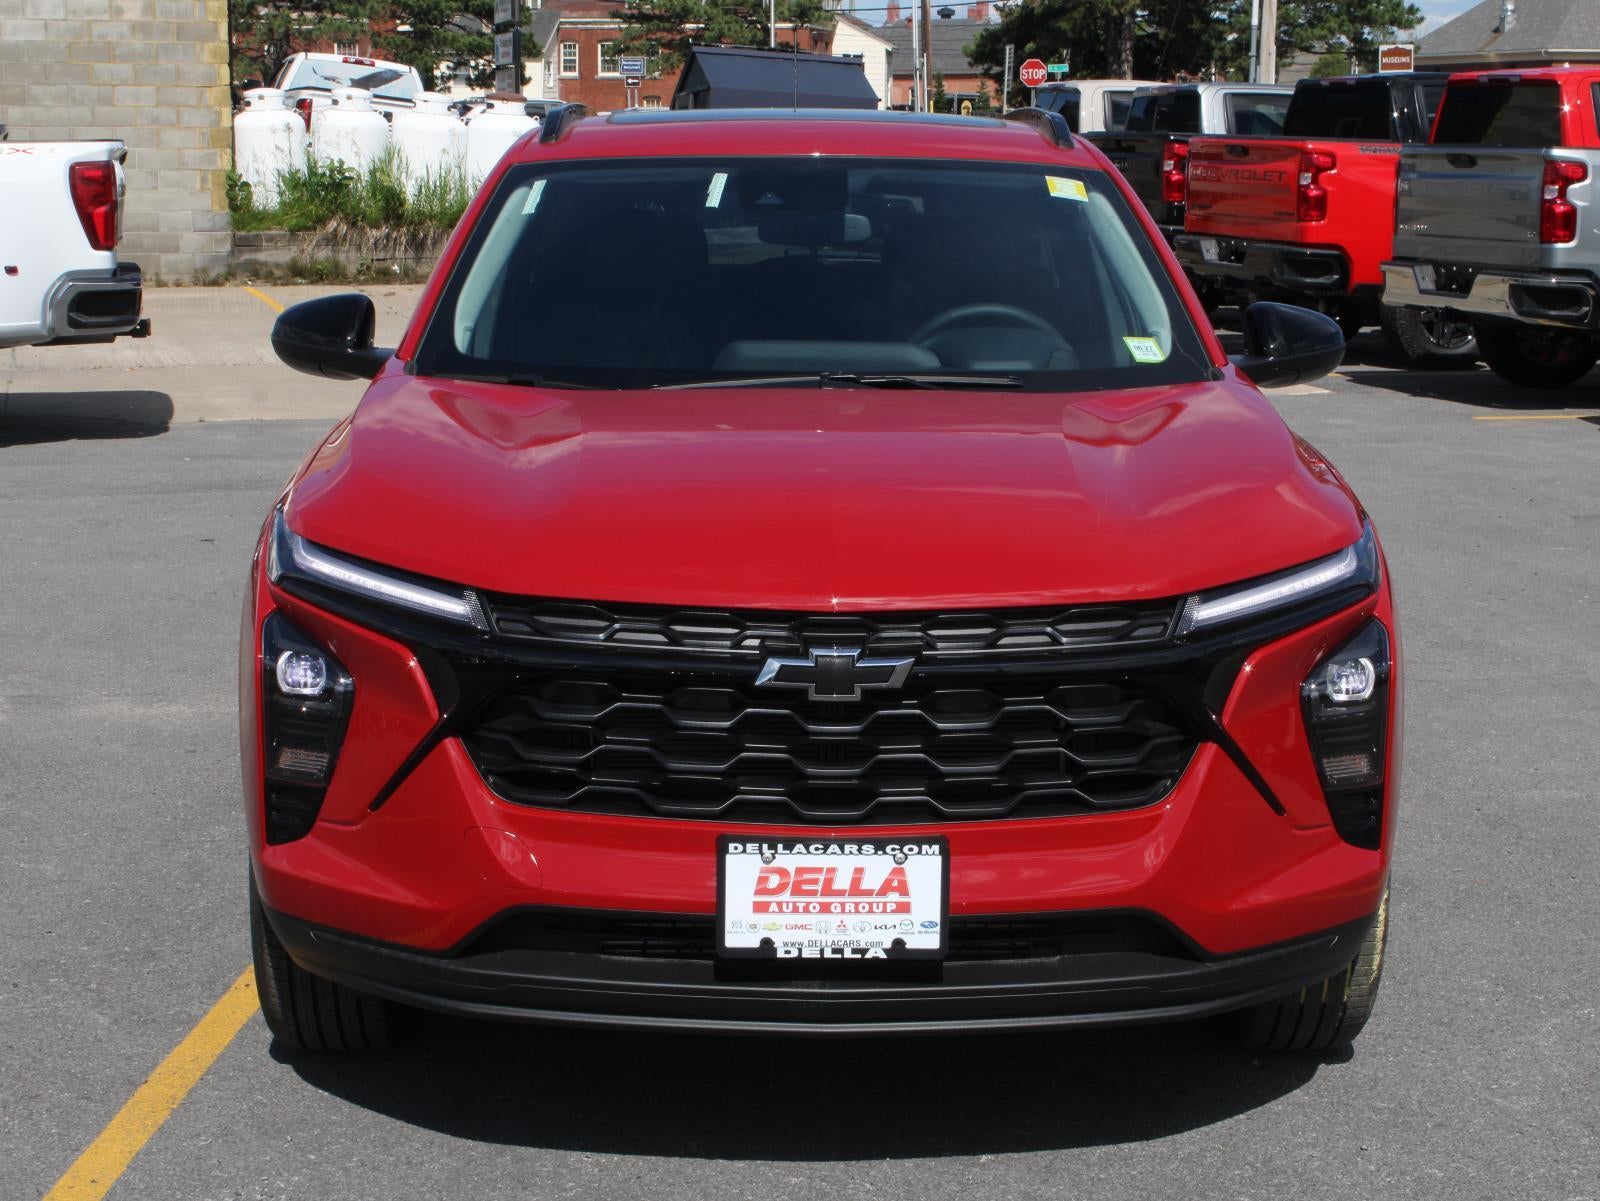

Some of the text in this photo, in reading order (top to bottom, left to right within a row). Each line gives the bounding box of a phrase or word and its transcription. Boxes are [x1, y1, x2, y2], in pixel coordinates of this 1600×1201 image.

[1022, 69, 1046, 79] STOP
[728, 843, 940, 855] DELLACARS.COM
[753, 866, 911, 897] DELLA
[768, 902, 897, 913] AUTO GROUP
[785, 923, 814, 931] GMC
[782, 940, 884, 948] www.DELLACARS.com
[776, 947, 888, 958] DELLA
